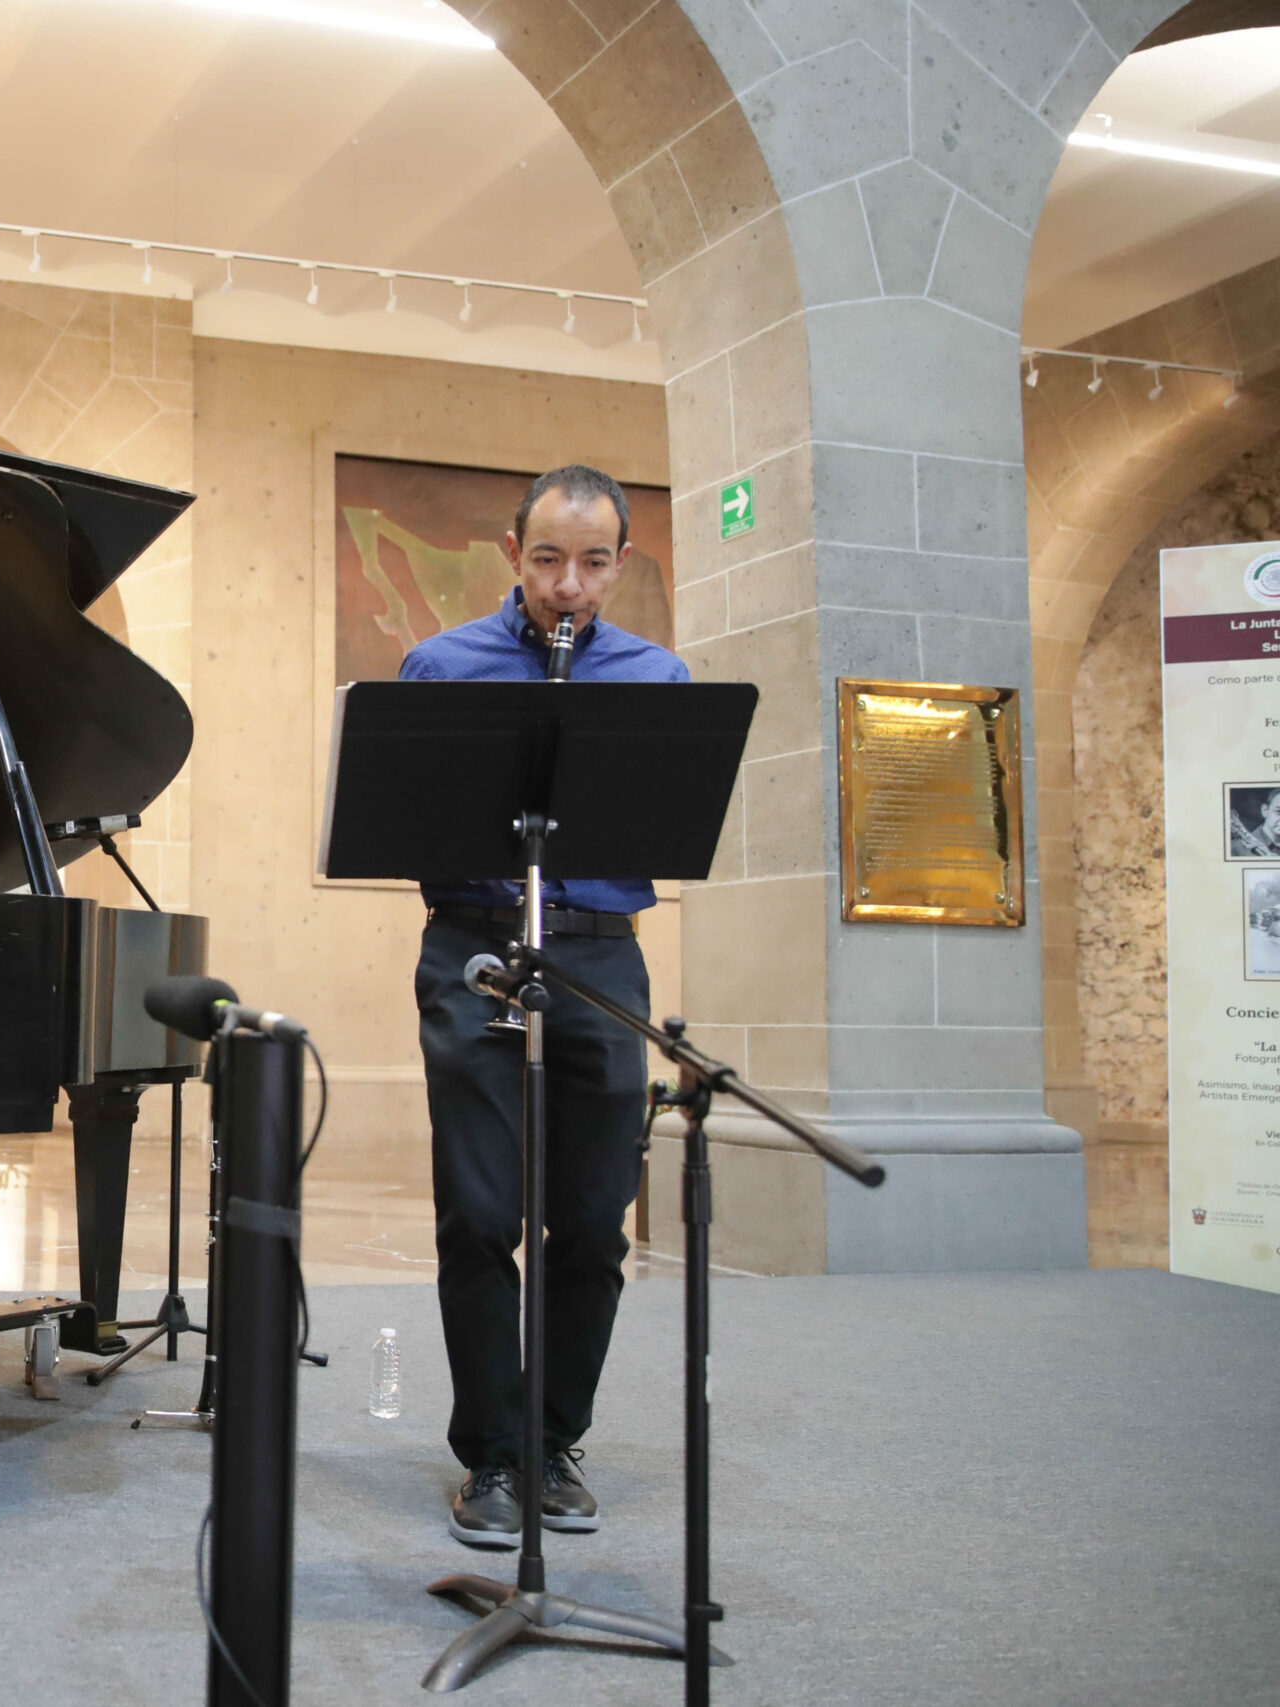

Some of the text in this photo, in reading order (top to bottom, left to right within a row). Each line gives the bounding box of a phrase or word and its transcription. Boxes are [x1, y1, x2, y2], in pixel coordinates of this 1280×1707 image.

[1230, 620, 1246, 630] La
[1207, 676, 1241, 685] Como
[1244, 674, 1274, 686] parte
[1265, 717, 1280, 727] Fe
[1197, 1080, 1250, 1091] Asimismo,
[1200, 1091, 1239, 1101] Artistas
